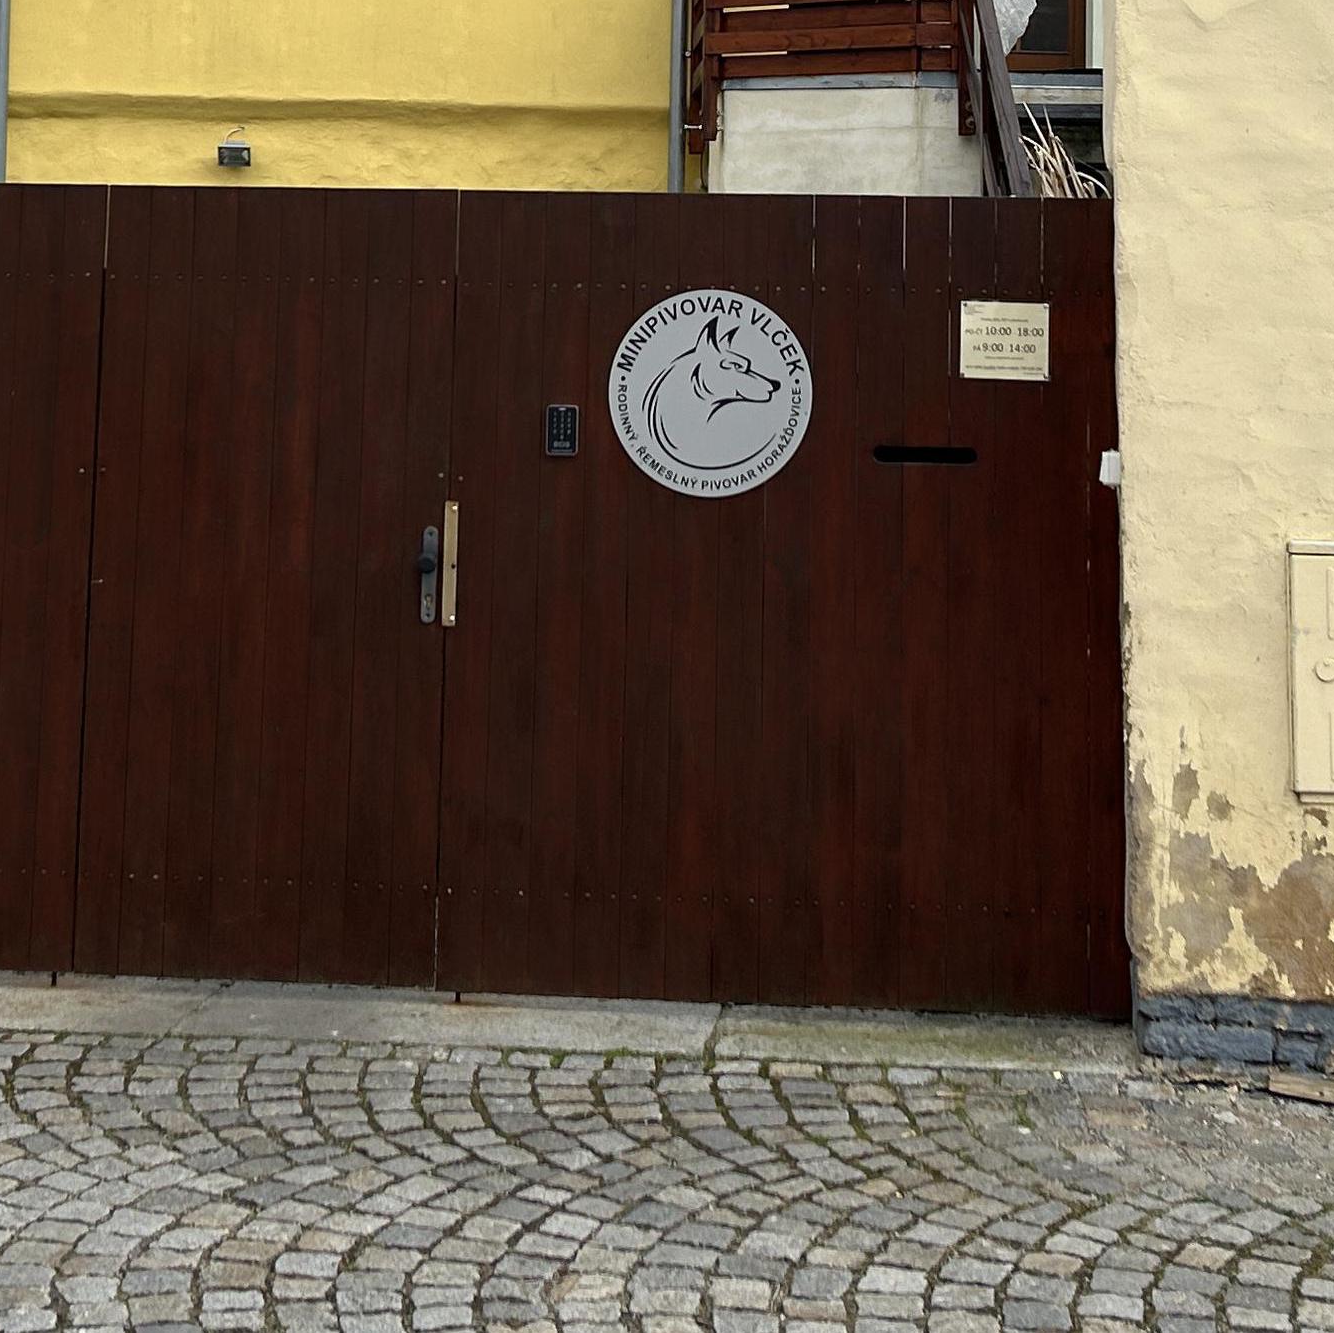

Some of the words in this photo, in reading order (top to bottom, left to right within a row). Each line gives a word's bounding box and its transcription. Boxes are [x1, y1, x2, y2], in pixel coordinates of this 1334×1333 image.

[617, 296, 742, 373] MINIPIVOVAR
[750, 307, 805, 377] VLČEK
[982, 342, 1004, 352] 9:00
[1009, 344, 1037, 354] 14:00
[985, 326, 1012, 336] 10:00
[635, 445, 698, 490] ŘEMESLNÝ
[700, 468, 757, 491] PIVOVAR
[757, 386, 803, 475] HORAŽĎOVICE
